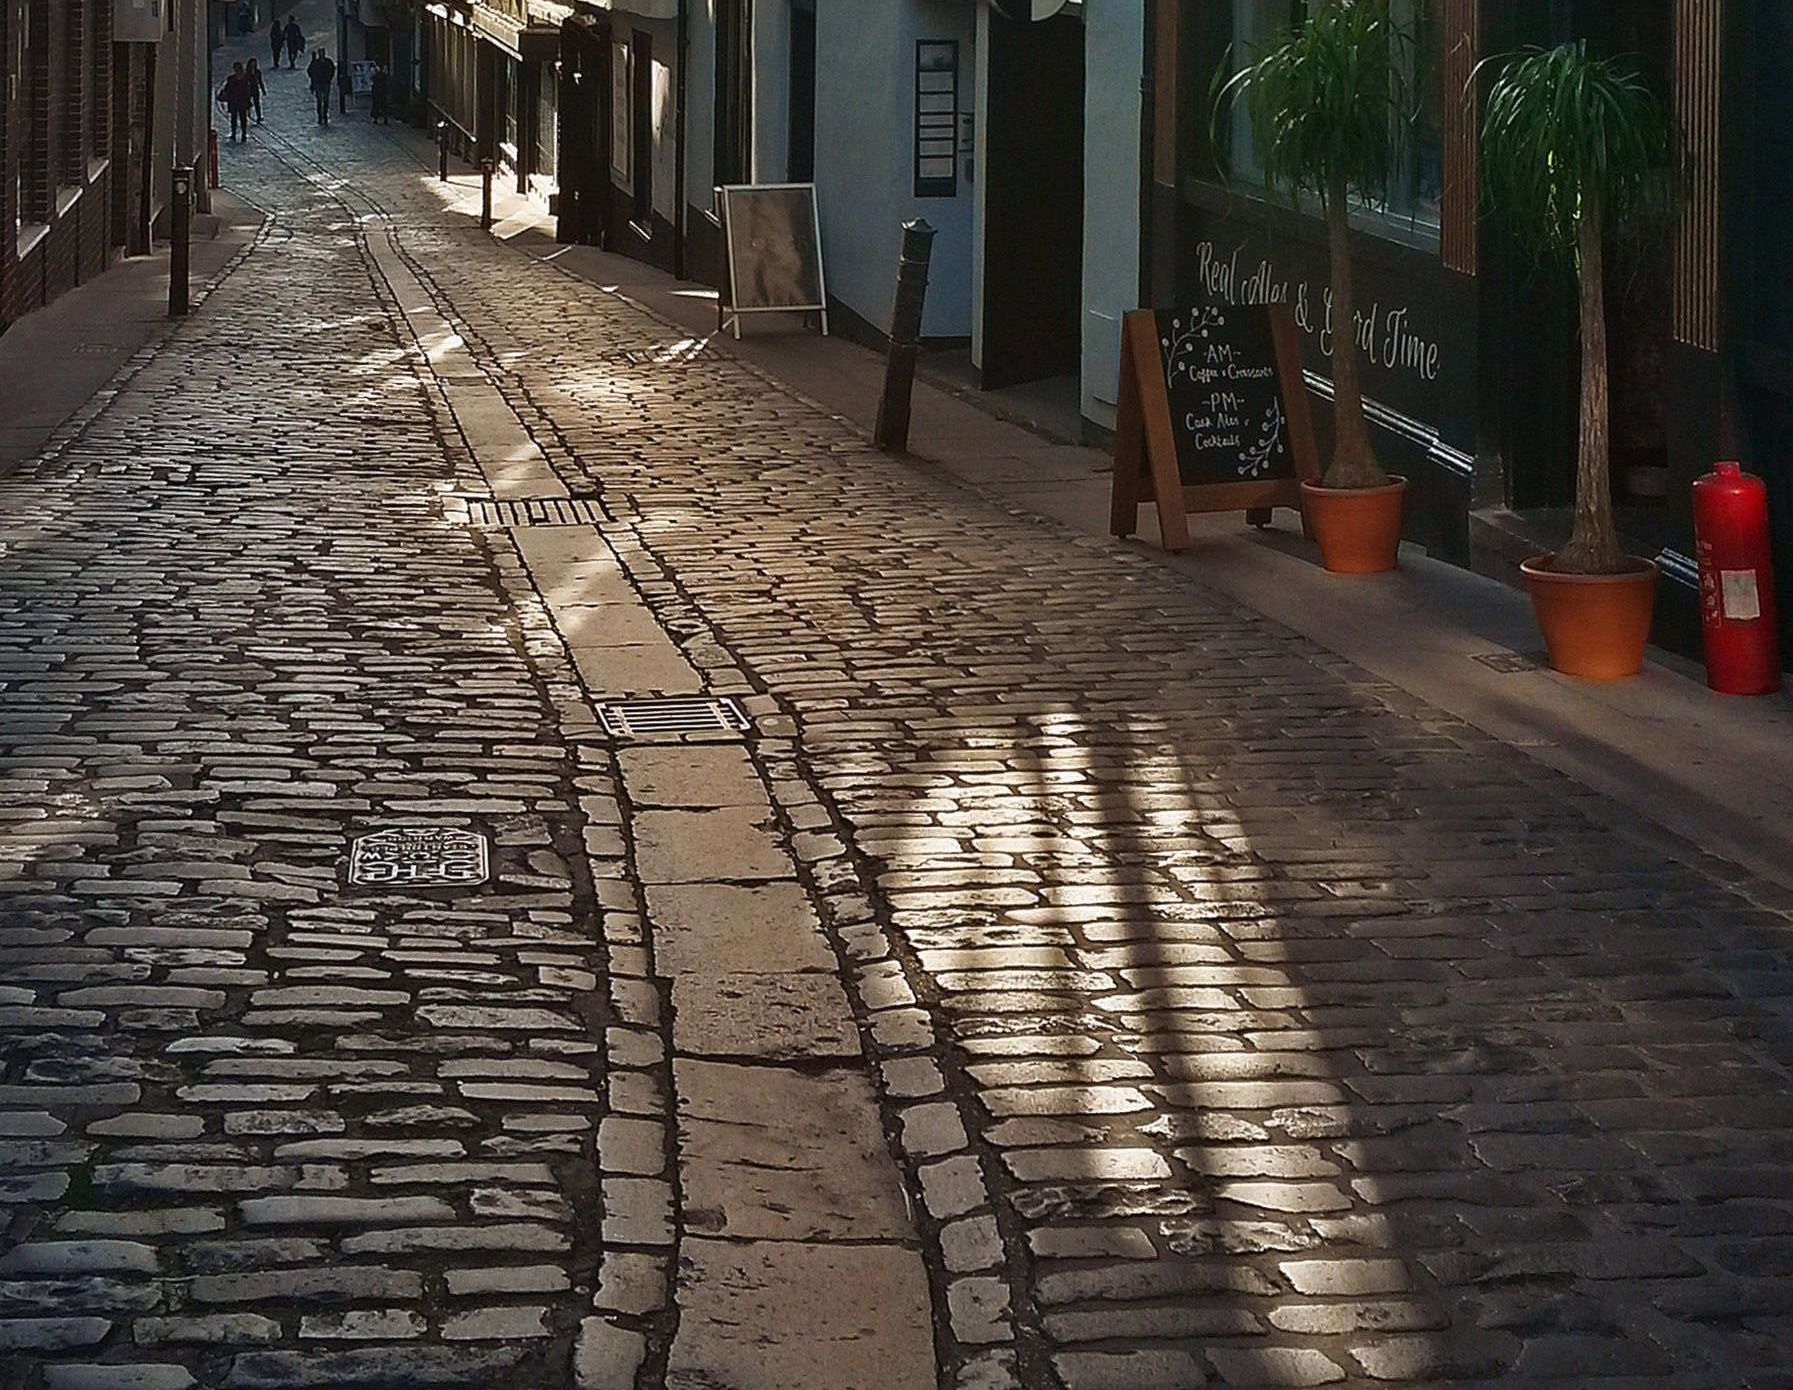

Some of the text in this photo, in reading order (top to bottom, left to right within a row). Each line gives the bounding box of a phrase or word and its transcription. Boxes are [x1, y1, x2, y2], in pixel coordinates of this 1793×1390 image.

[1196, 241, 1241, 305] Real
[1295, 280, 1314, 333] &
[1320, 286, 1378, 364] Gd
